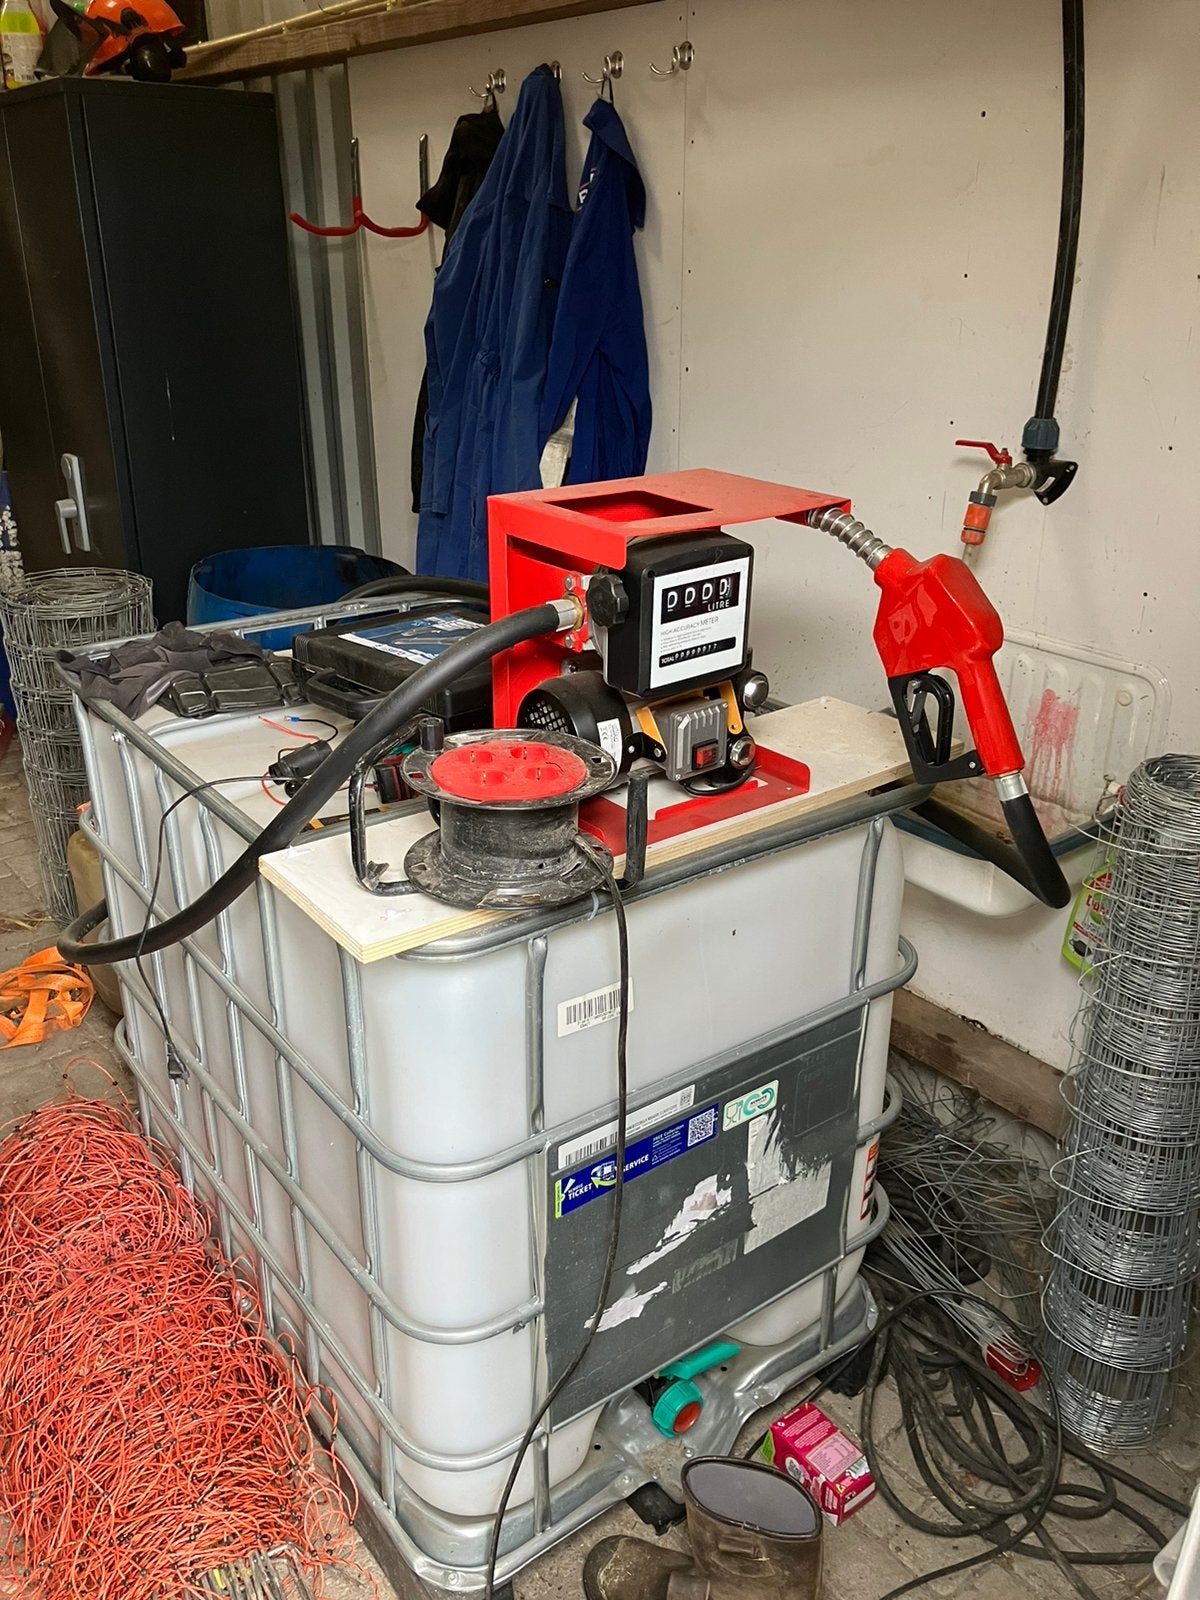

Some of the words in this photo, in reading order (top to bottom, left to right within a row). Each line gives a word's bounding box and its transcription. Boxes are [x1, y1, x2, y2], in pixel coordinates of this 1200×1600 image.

[707, 599, 730, 612] LITRE
[700, 615, 719, 626] METER
[568, 1182, 593, 1201] TICKET
